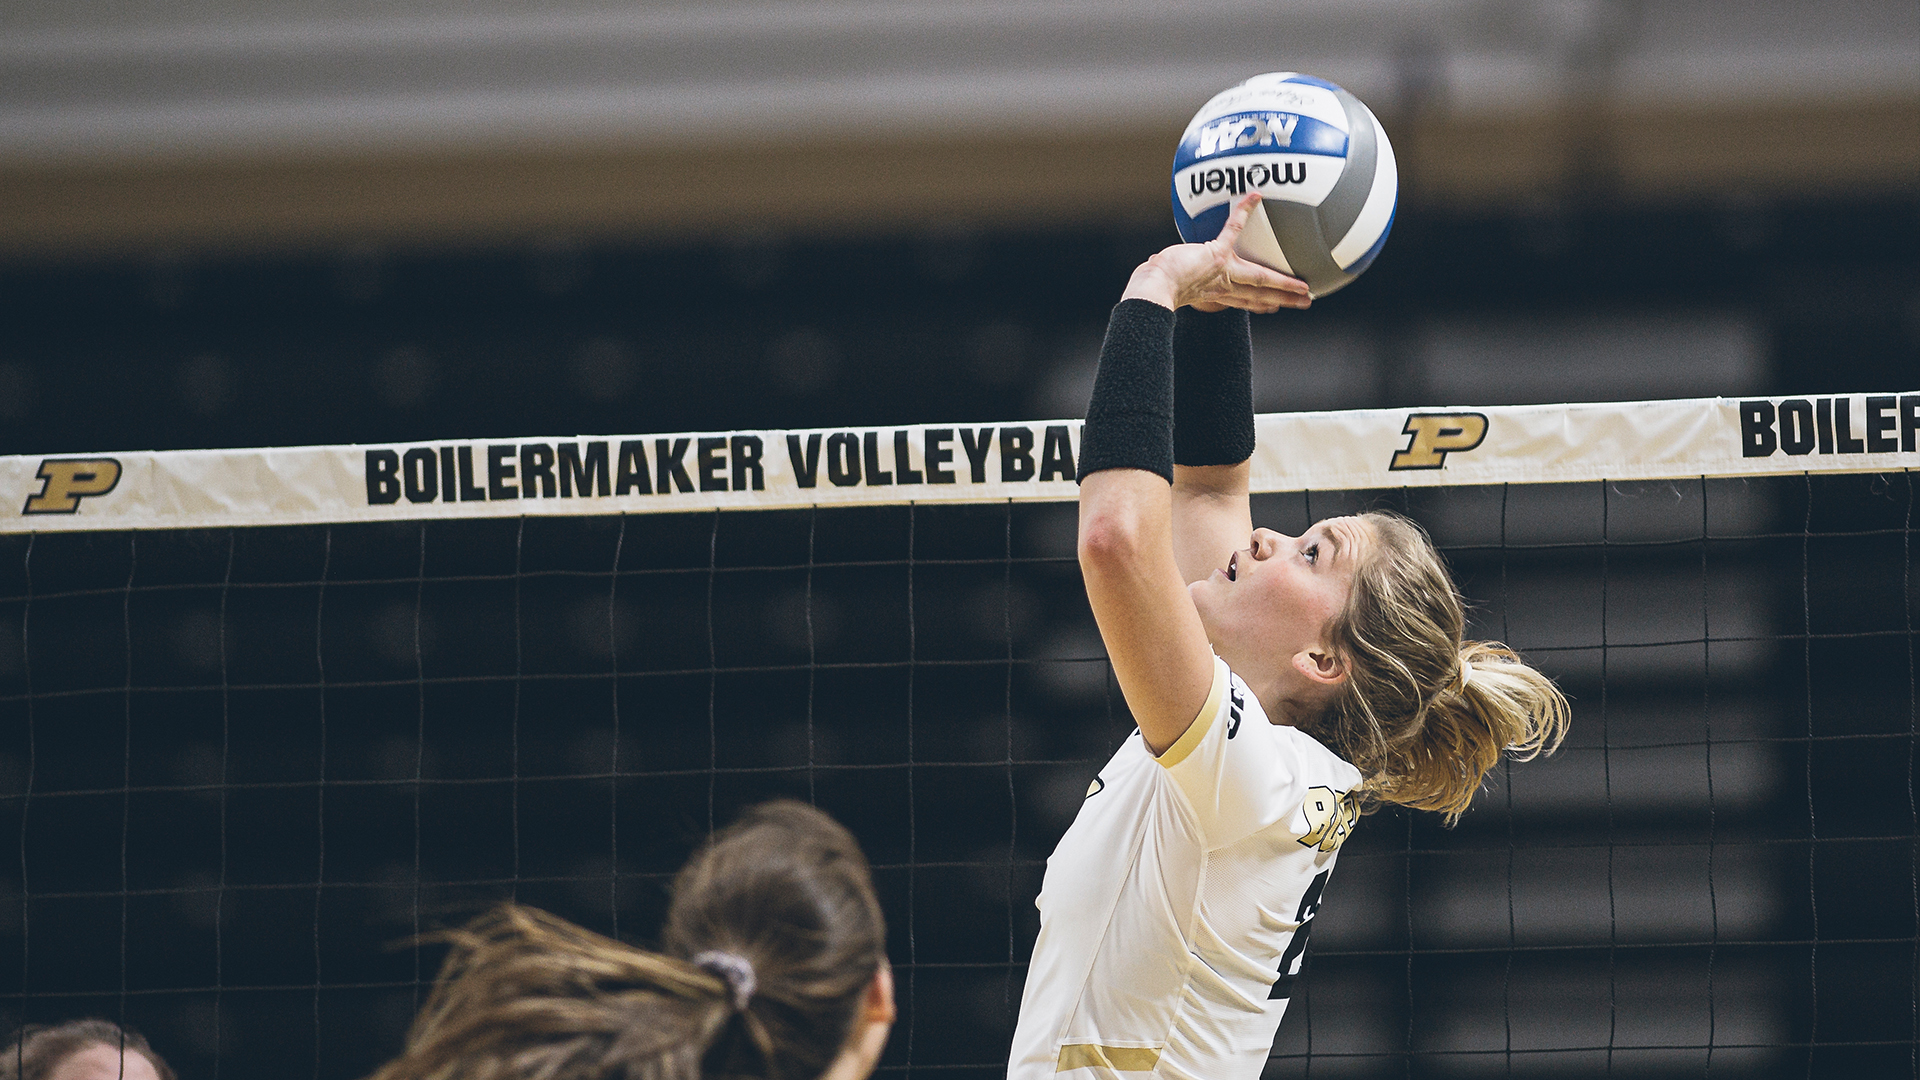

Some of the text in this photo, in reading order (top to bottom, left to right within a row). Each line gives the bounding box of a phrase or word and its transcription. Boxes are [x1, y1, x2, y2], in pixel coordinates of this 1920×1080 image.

[1200, 117, 1299, 157] NCAA
[1190, 161, 1307, 197] molten
[365, 425, 1084, 505] BOILERMAKER VOLLEYBA
[1388, 412, 1490, 471] P
[22, 458, 123, 515] P
